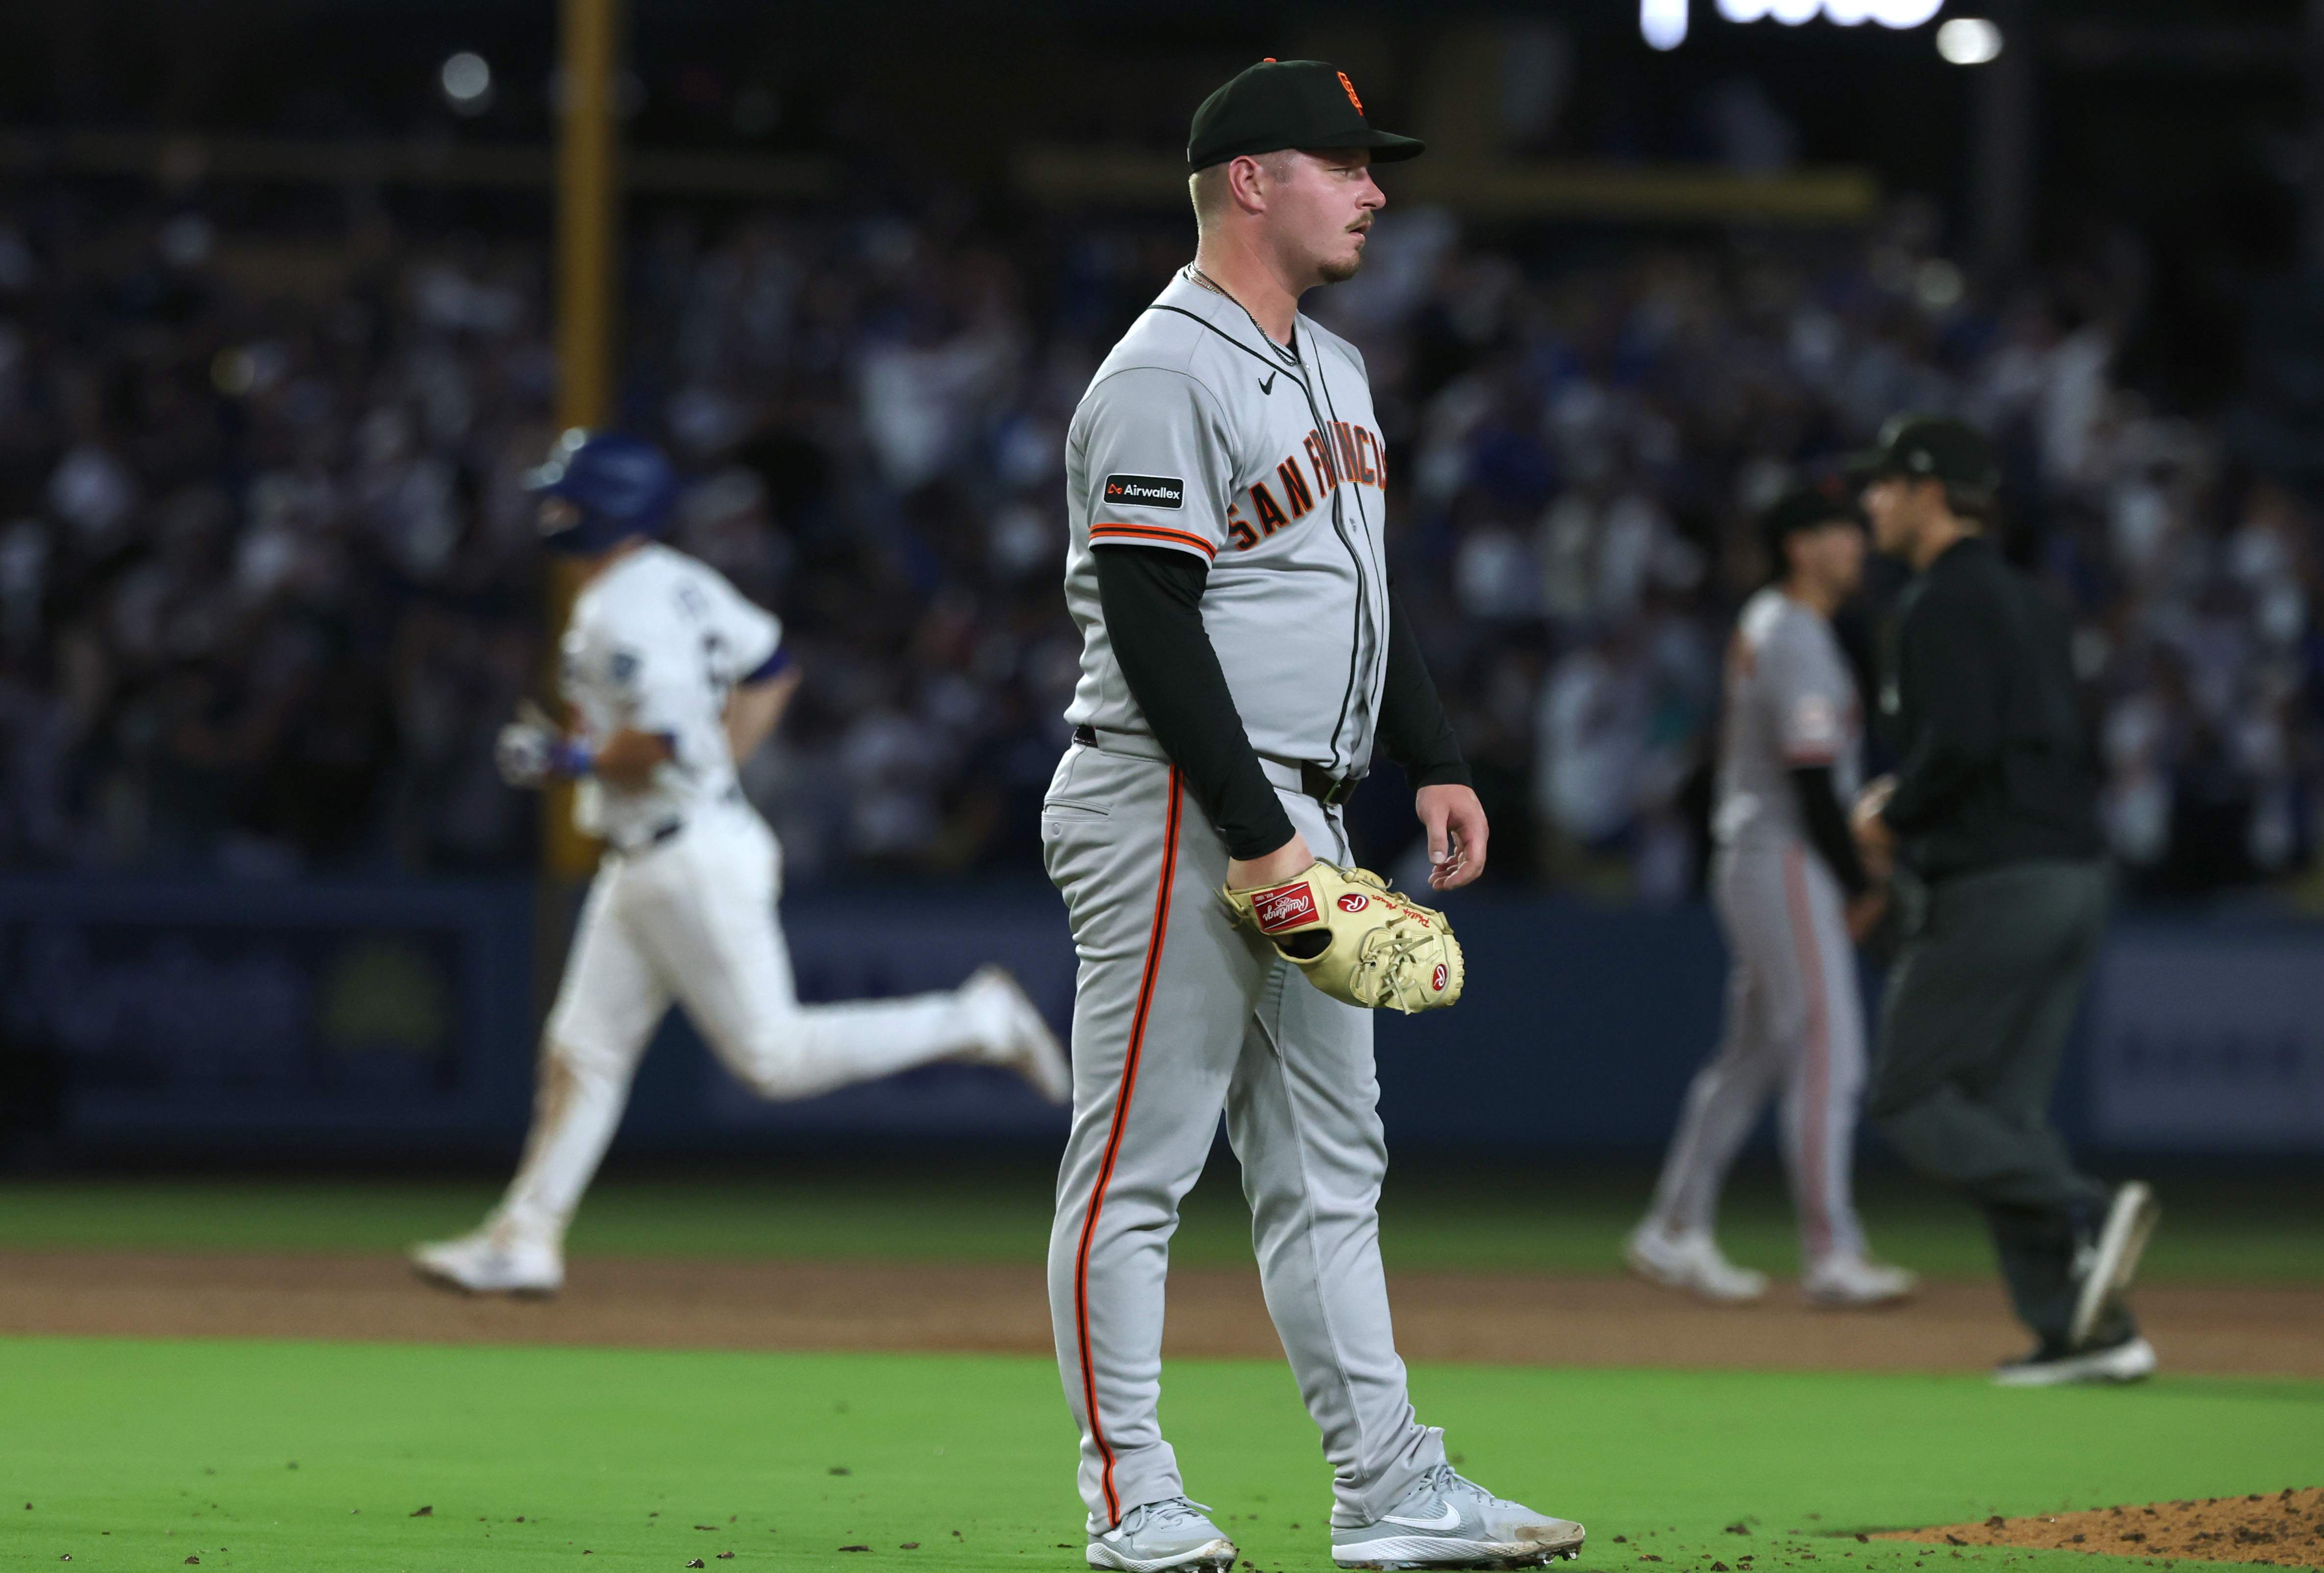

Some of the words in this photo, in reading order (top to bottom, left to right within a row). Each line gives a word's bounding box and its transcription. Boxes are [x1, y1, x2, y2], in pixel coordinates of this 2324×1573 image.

[1124, 484, 1181, 500] Airwallex
[1227, 455, 1315, 551] SAN
[1262, 895, 1309, 921] Rawlings
